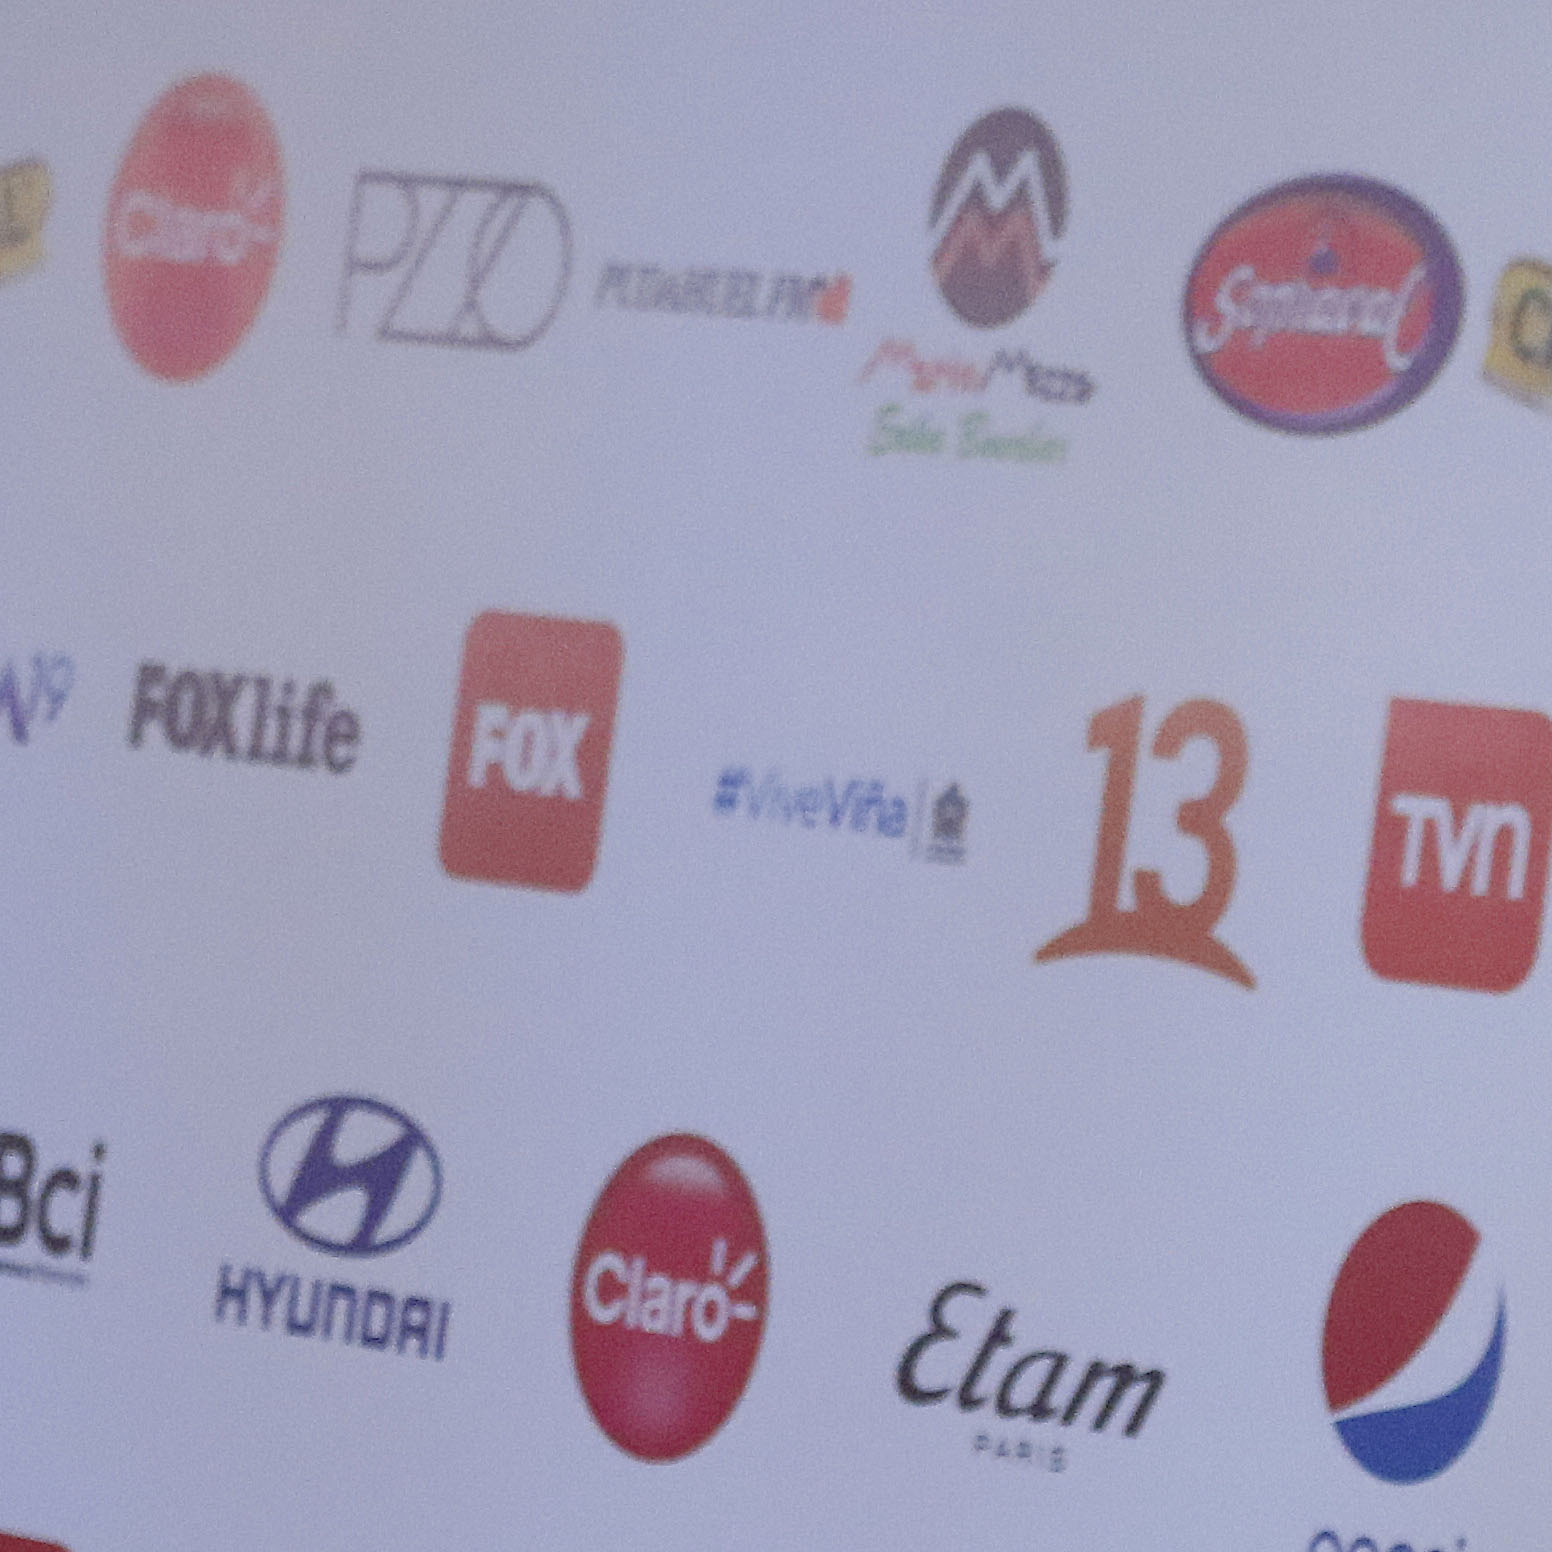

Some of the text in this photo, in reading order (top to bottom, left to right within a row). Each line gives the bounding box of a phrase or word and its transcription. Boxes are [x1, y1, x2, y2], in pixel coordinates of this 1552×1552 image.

[467, 701, 594, 801] FOX
[1086, 694, 1250, 945] 13
[214, 1263, 452, 1362] HYUNDAI
[584, 1249, 730, 1343] Claro
[895, 1279, 1166, 1438] Etam
